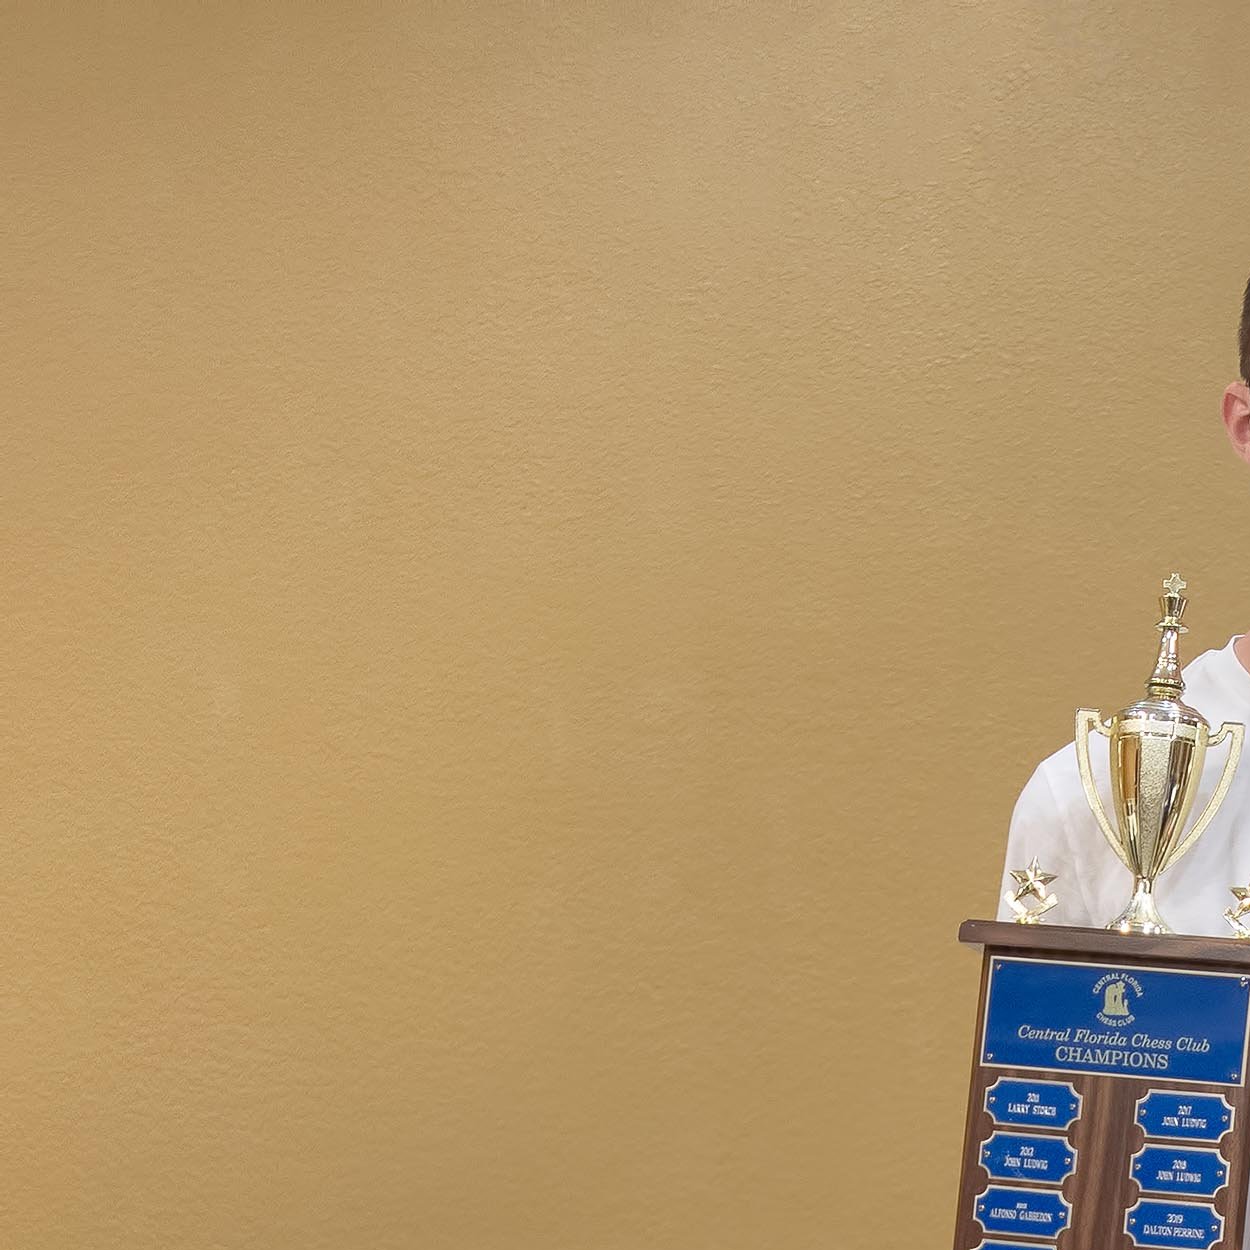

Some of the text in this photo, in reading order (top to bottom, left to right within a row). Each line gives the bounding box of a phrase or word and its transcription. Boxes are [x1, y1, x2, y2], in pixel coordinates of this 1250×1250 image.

[1092, 972, 1144, 998] CENTRAL FLORIDA
[1096, 1011, 1136, 1027] CHESS CLUB
[1018, 1025, 1210, 1053] Central Florida Chess Club
[1055, 1045, 1169, 1070] CHAMPIONS
[1007, 1103, 1030, 1115] LARRY
[1161, 1116, 1207, 1129] JOHN LUDWIG
[1003, 1155, 1048, 1170] JOHN LUDWIG
[1156, 1170, 1201, 1183] JOHN LUDWIG
[1143, 1224, 1205, 1239] DALTON PERRINE
